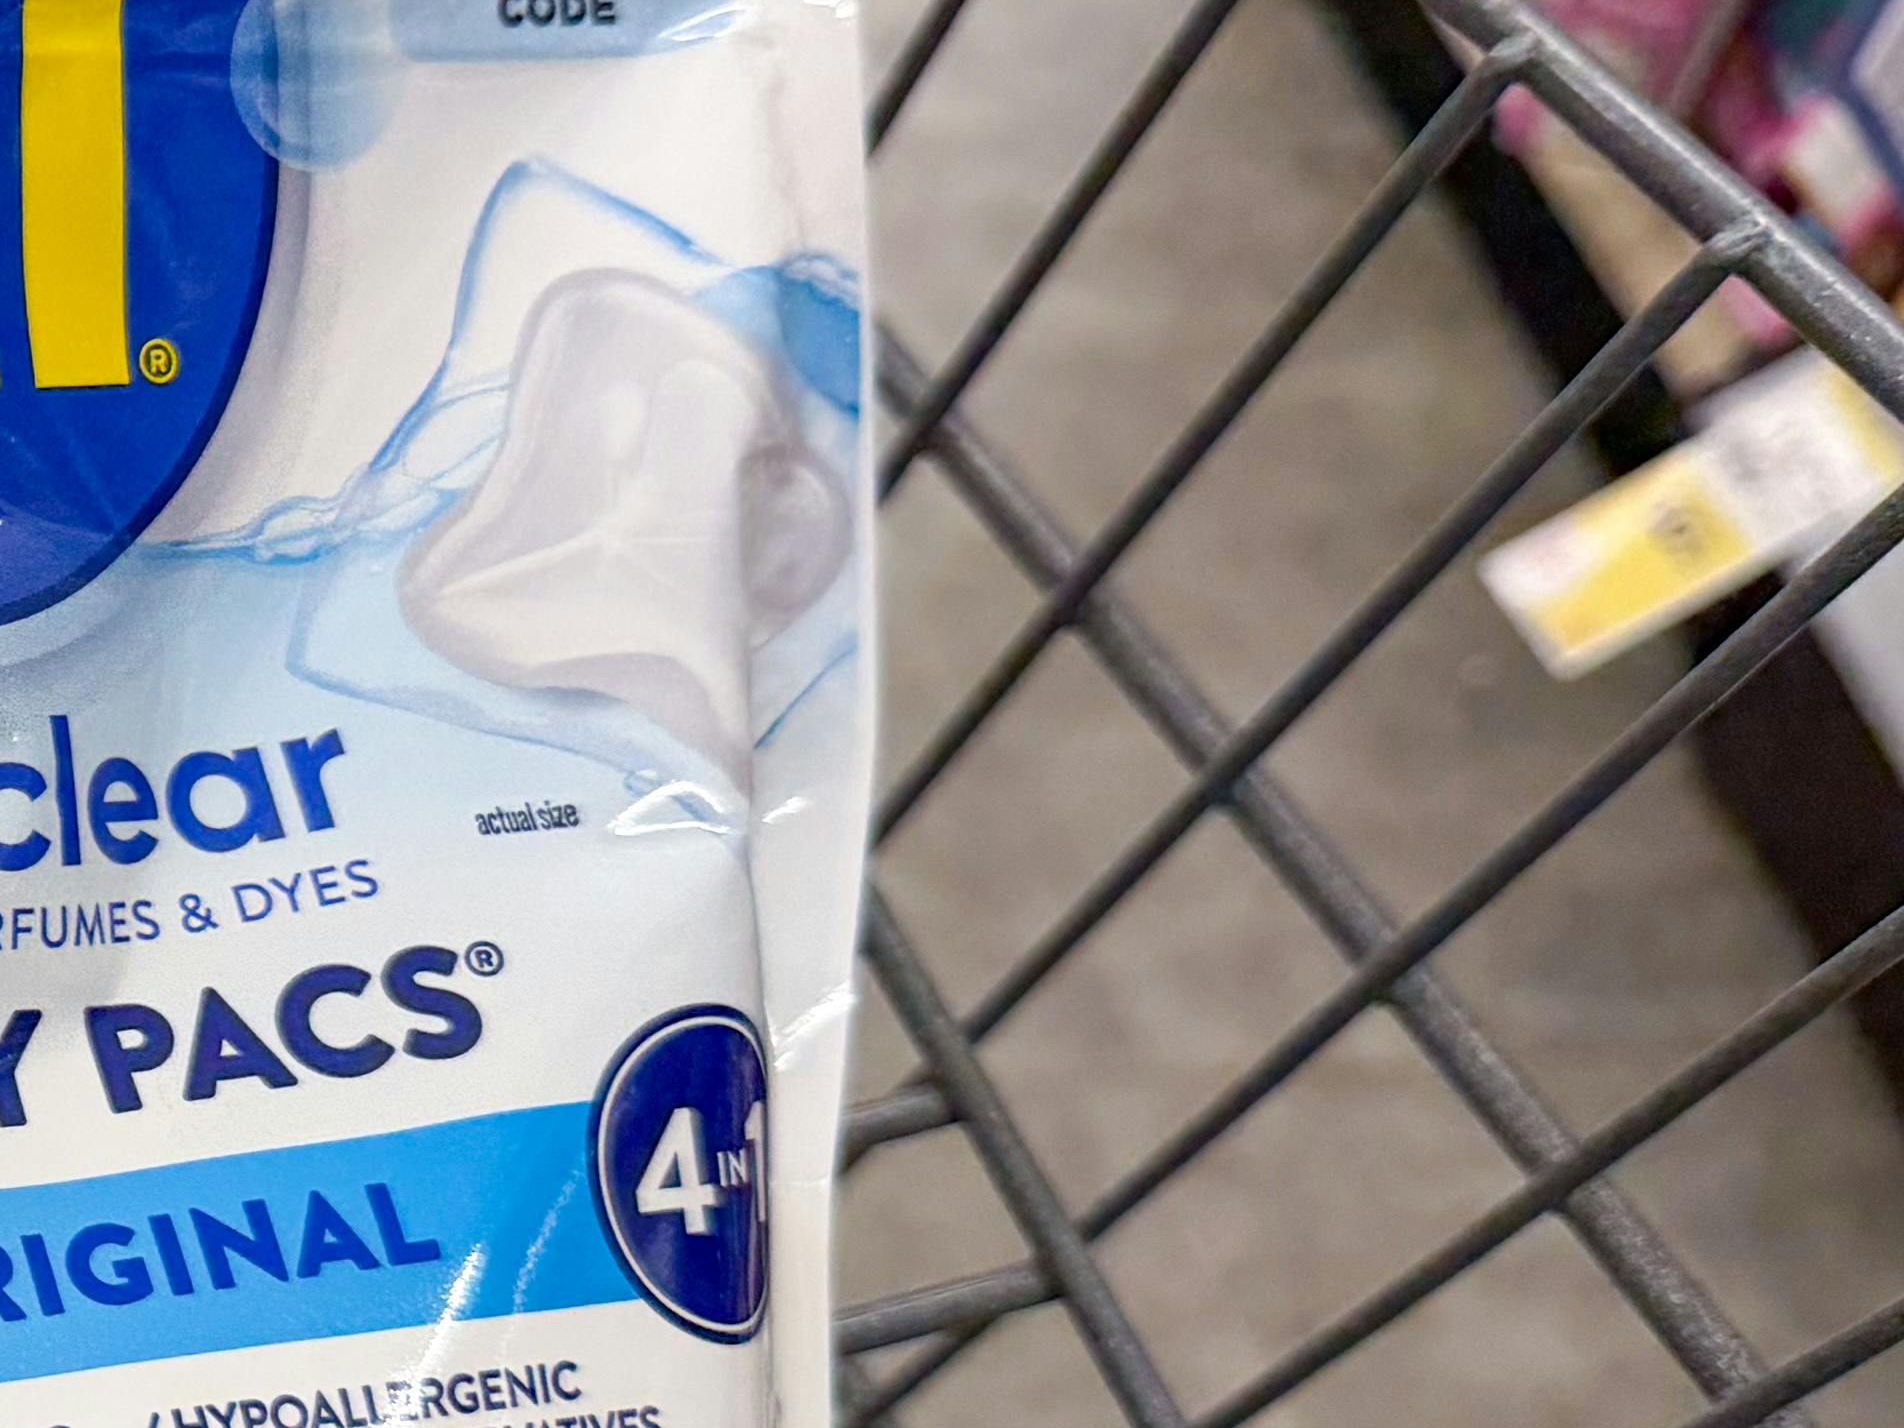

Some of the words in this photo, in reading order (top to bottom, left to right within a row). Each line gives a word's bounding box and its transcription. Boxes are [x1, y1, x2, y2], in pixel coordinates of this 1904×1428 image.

[474, 802, 538, 836] actual
[539, 800, 581, 831] size
[178, 890, 221, 934] &
[233, 858, 382, 920] DYES
[635, 1105, 722, 1236] 4
[717, 1147, 750, 1188] IN
